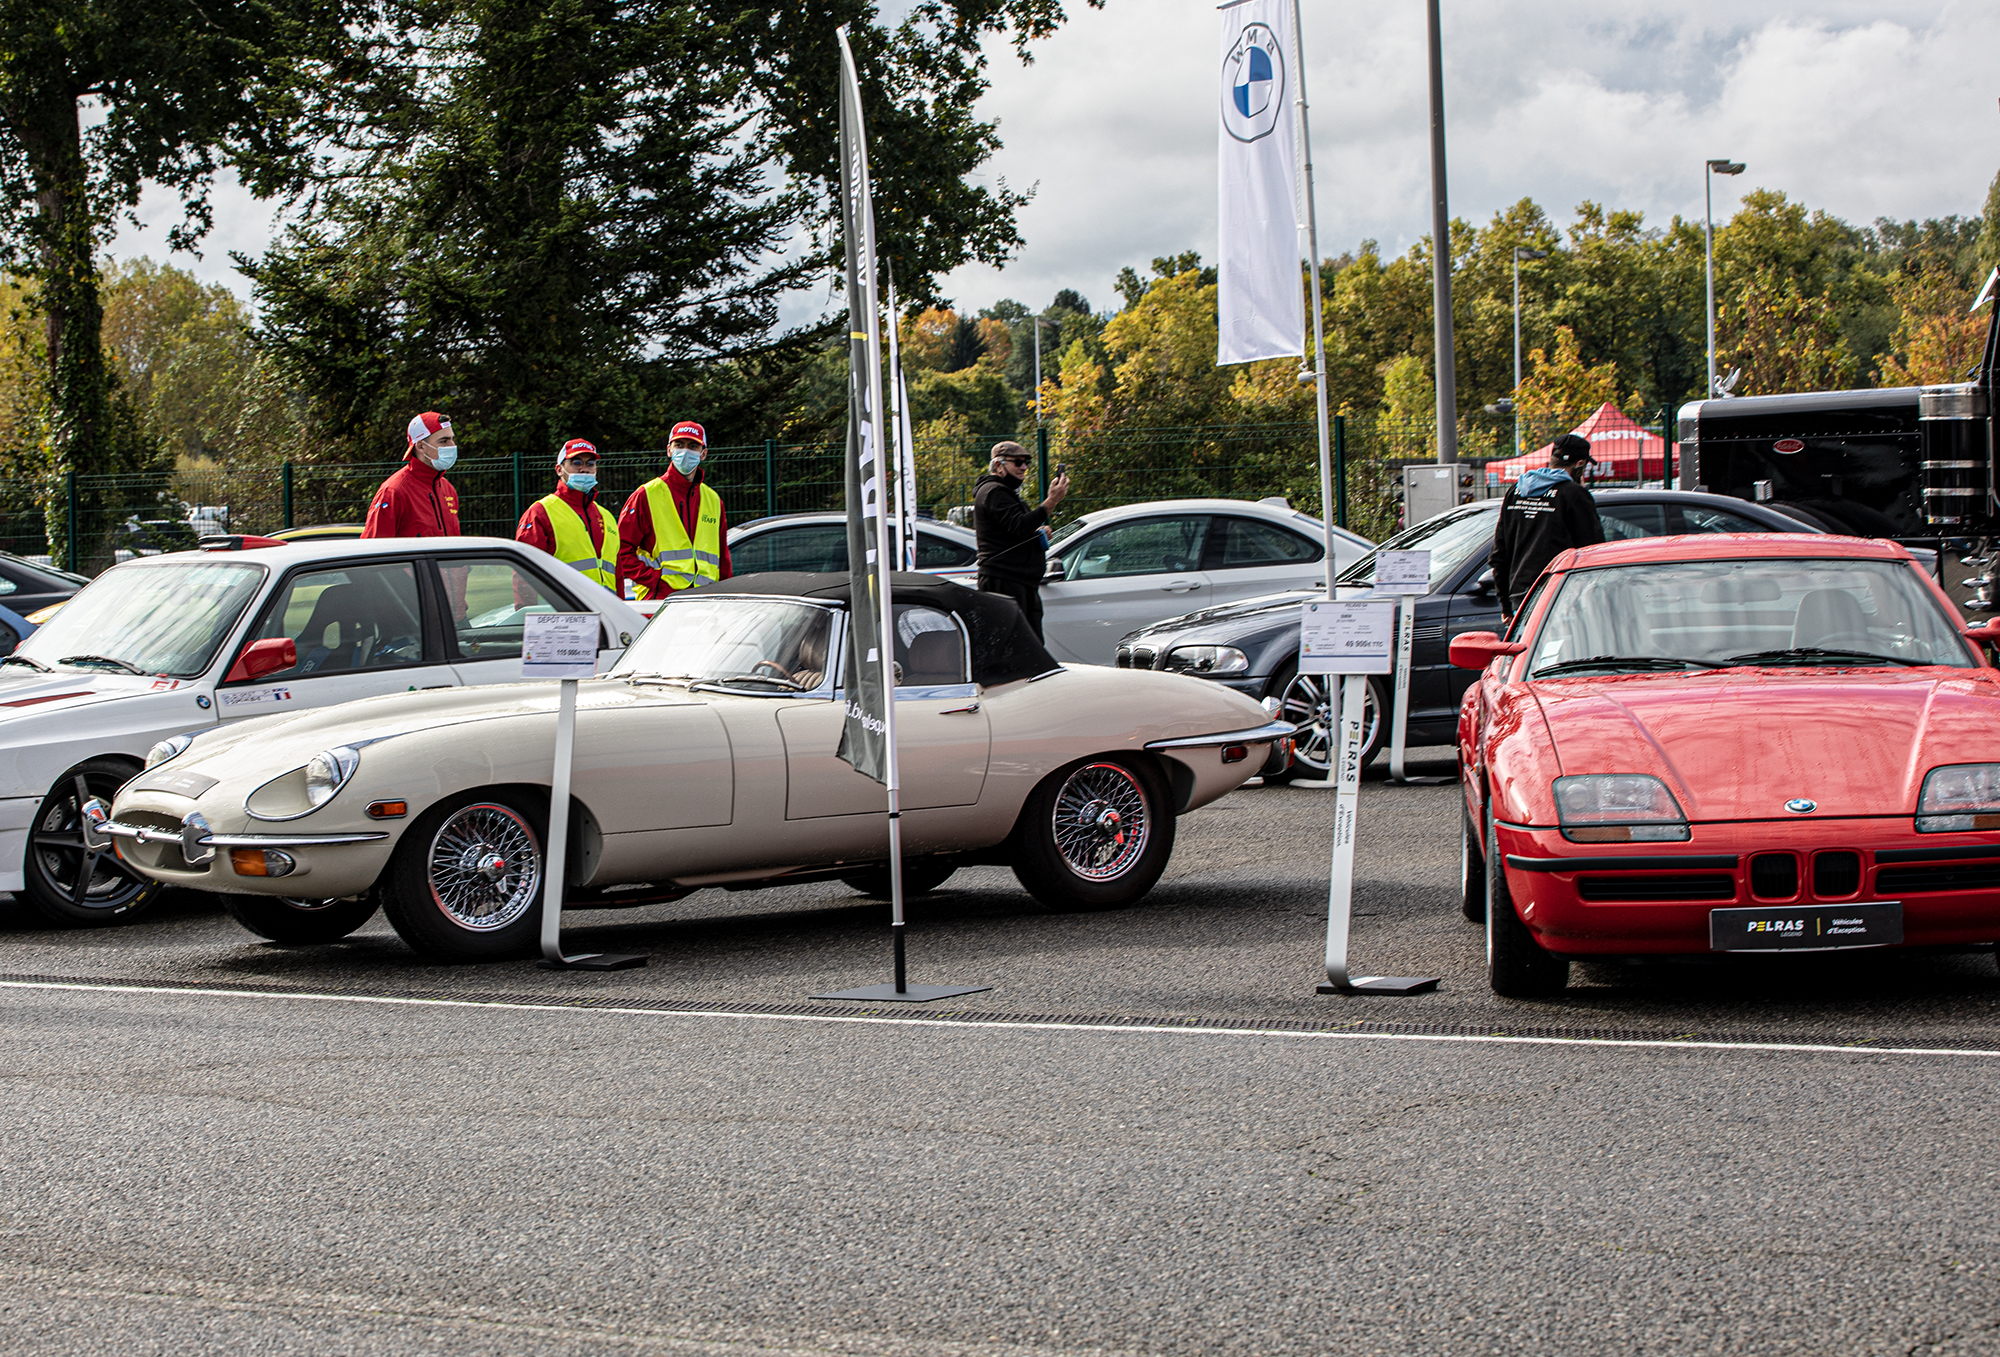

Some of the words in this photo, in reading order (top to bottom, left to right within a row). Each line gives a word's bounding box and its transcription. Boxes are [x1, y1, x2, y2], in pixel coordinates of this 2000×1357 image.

[677, 427, 699, 436] MOTUL
[1591, 430, 1653, 442] MOTUL
[566, 616, 587, 624] VENTE
[1345, 720, 1360, 783] PELRAS
[1747, 919, 1804, 932] PELRAS
